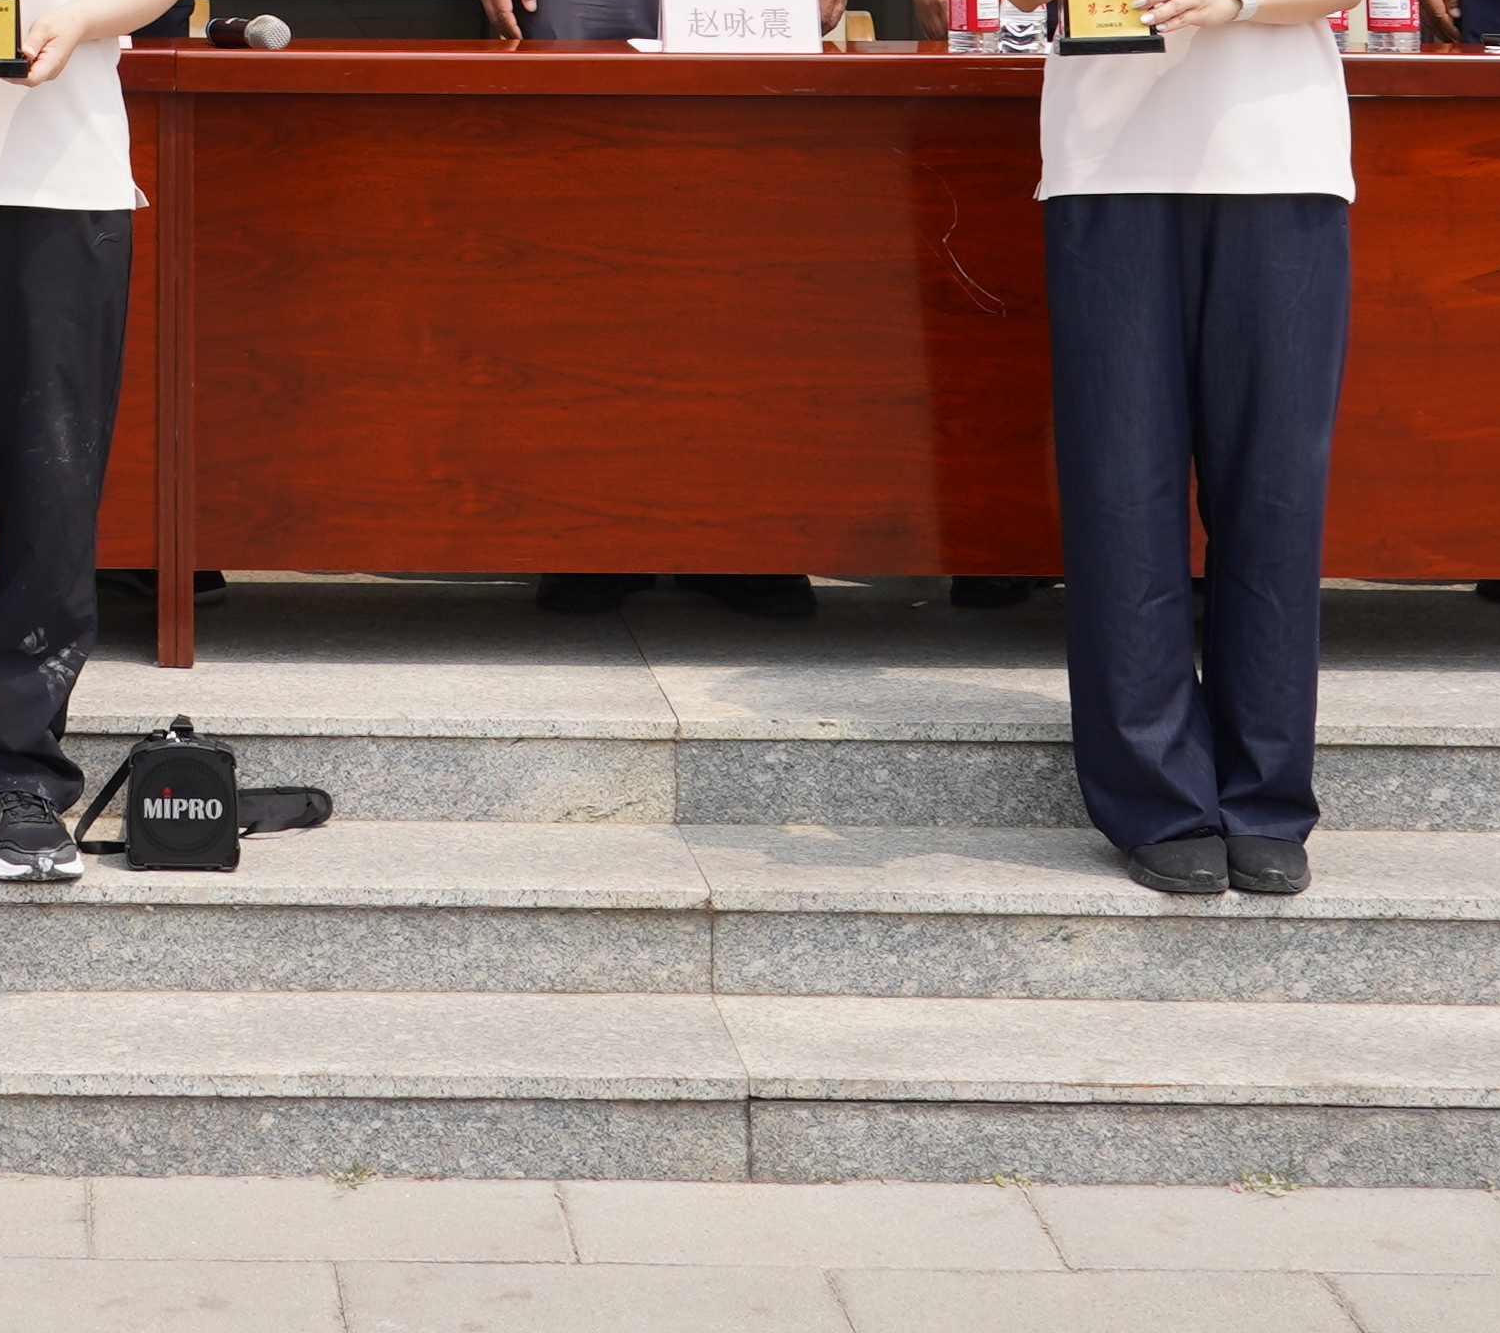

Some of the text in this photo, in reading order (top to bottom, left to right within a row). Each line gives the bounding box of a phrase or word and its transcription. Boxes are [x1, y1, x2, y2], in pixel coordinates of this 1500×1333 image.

[686, 6, 794, 39] 赵咏震
[142, 794, 224, 820] MIPRO
